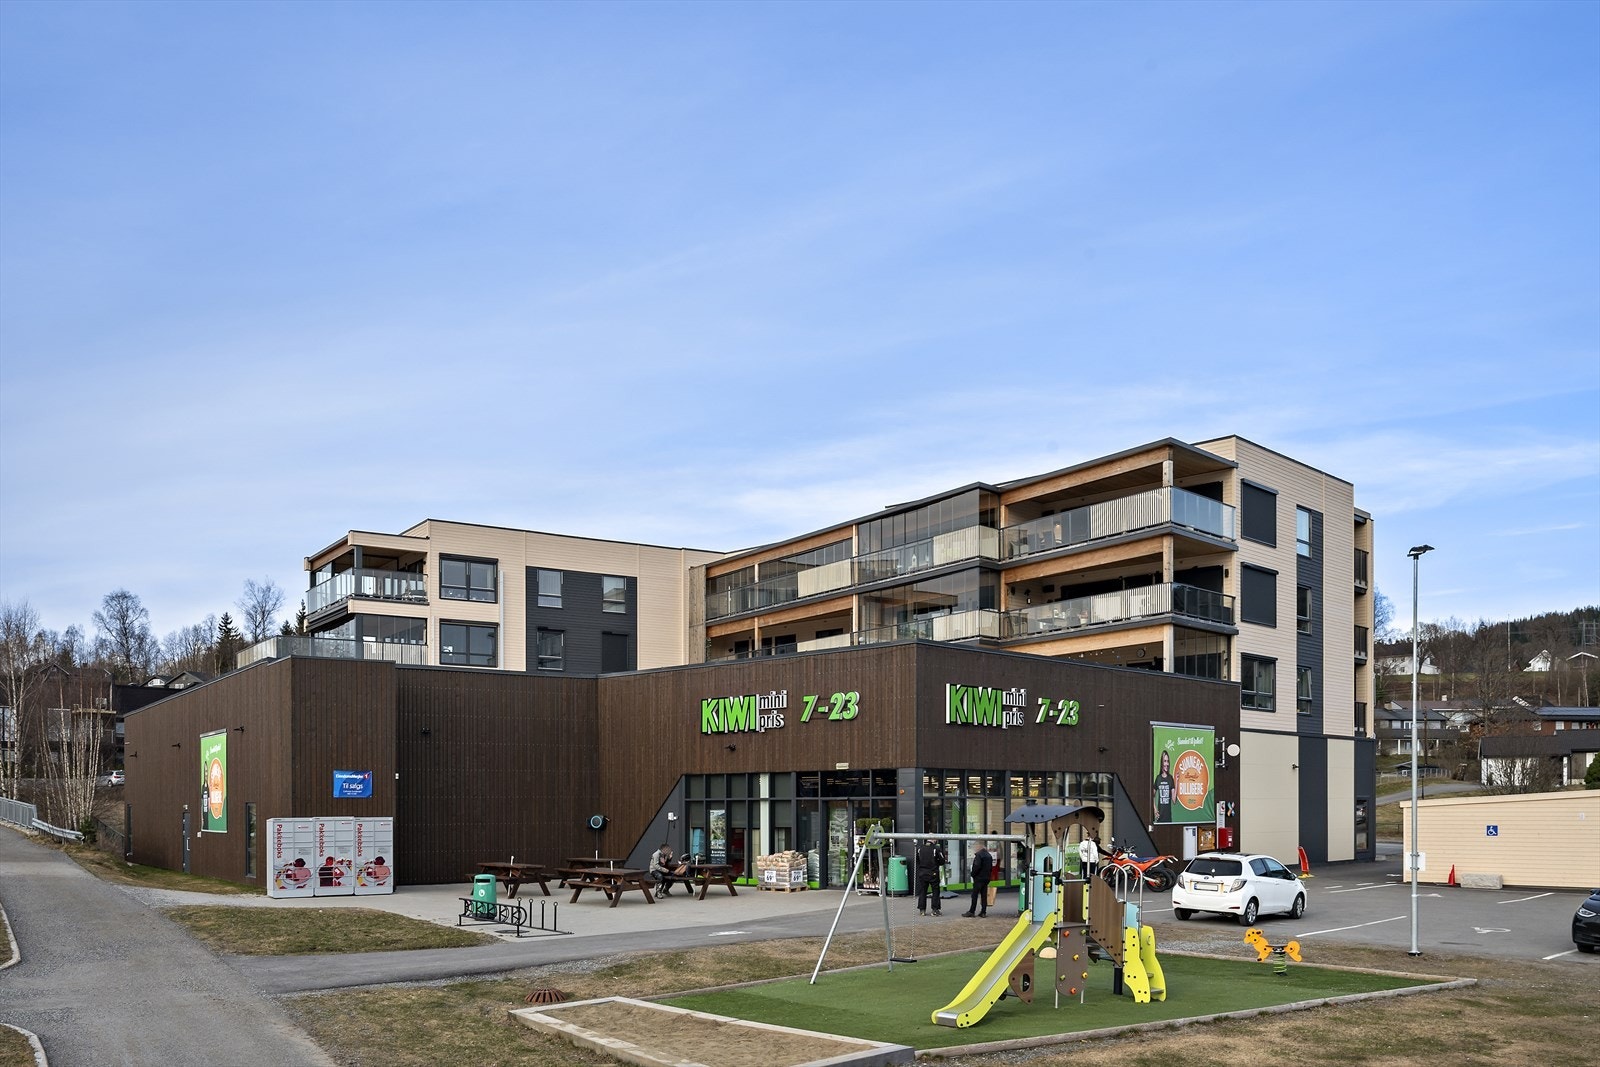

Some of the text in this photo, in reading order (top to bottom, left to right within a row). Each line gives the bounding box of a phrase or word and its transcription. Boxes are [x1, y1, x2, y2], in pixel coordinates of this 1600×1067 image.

[701, 694, 758, 734] KIWI
[759, 690, 860, 722] mini 7-23
[759, 710, 785, 732] pris
[946, 683, 1003, 727] KIWI
[1003, 688, 1080, 725] mini 7-23
[1003, 708, 1025, 729] pris
